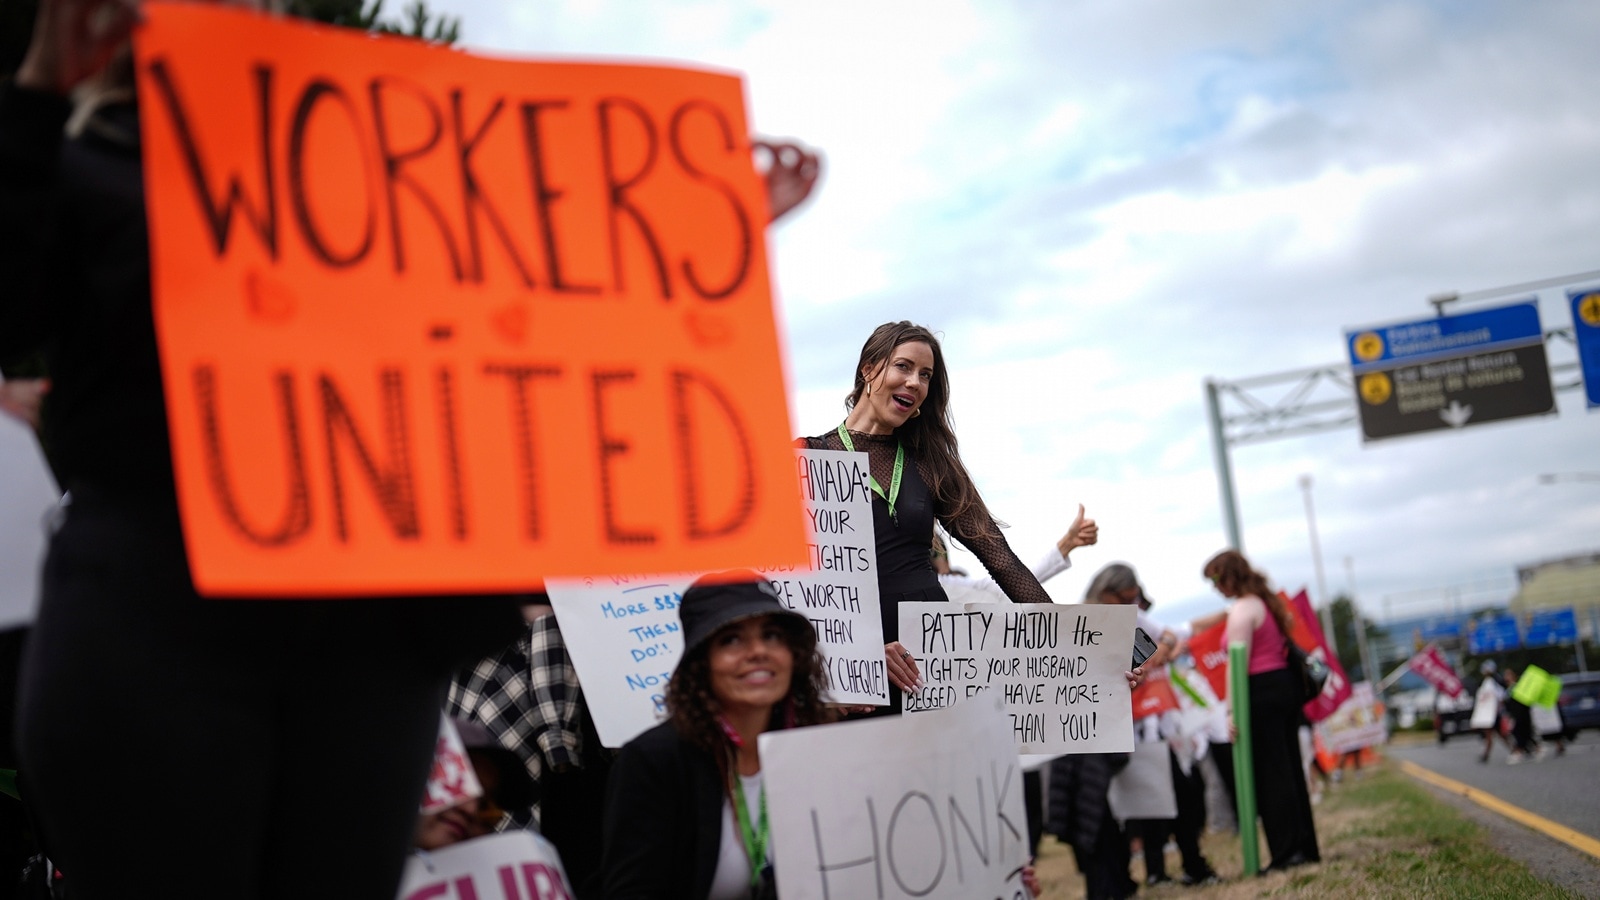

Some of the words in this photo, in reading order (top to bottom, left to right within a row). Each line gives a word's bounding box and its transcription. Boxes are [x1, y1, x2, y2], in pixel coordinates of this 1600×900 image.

[149, 57, 754, 301] WORKERS
[797, 455, 871, 503] ANADA:
[807, 508, 856, 535] YOUR
[806, 543, 870, 574] TIGHTS
[600, 601, 650, 619] MORE
[798, 581, 862, 614] WORTH
[628, 622, 680, 642] THEN
[809, 618, 854, 645] THAN
[921, 611, 993, 654] PATTY
[1003, 612, 1059, 650] HAJDU
[1071, 615, 1103, 647] the
[838, 657, 886, 699] CHEQUE!
[985, 656, 1021, 683] YOUR
[1026, 655, 1088, 680] HUSBAND
[904, 685, 957, 711] BEGGED
[1004, 683, 1045, 704] HAVE
[1055, 684, 1100, 707] MORE
[1059, 711, 1097, 742] YOU!
[810, 760, 1022, 900] HONK
